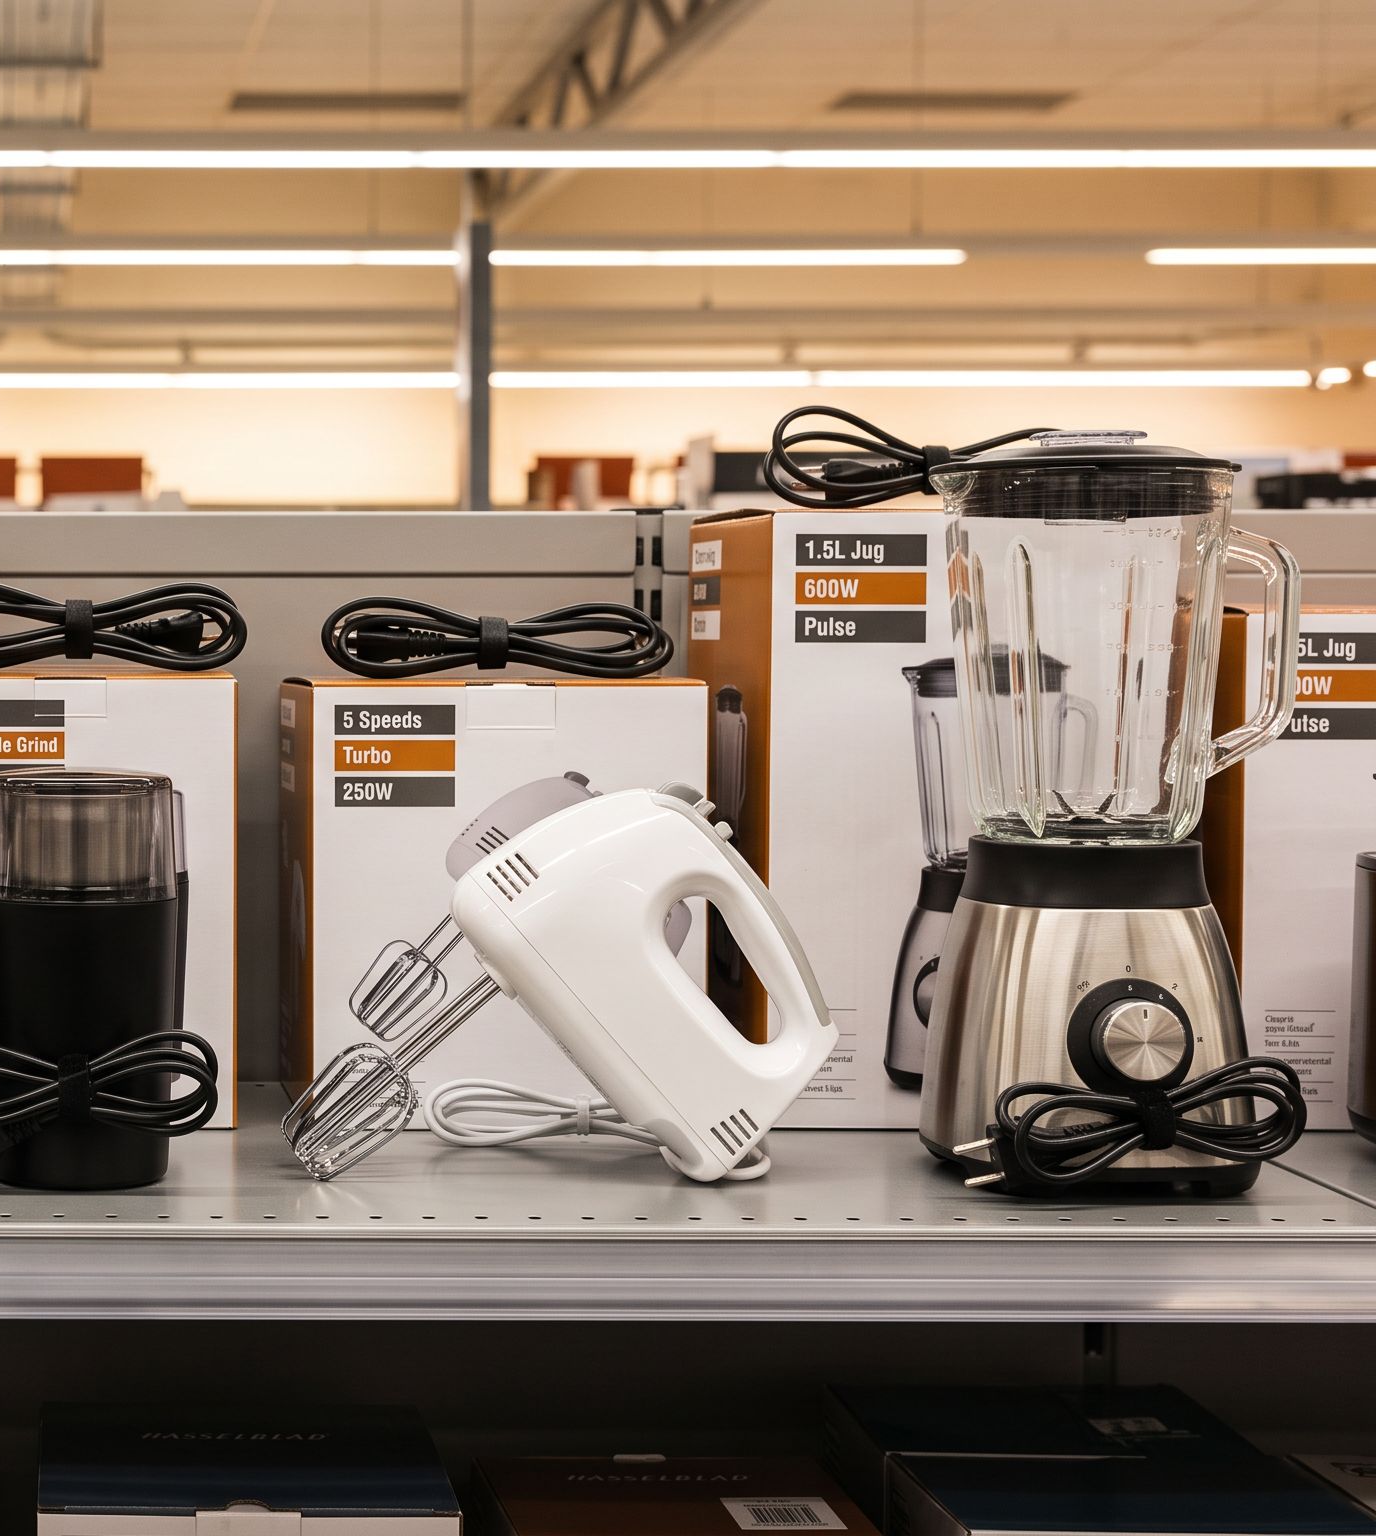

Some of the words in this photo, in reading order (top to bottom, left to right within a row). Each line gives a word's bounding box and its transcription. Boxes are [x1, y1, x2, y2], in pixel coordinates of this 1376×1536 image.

[805, 540, 846, 560] 1.5L
[850, 540, 884, 564] Jug
[804, 578, 859, 598] 600W
[804, 616, 856, 637] Pulse
[1298, 638, 1319, 657] 5L
[1322, 638, 1356, 662] Jug
[1296, 675, 1333, 696] 00W
[343, 711, 354, 729] 5
[359, 711, 422, 733] Speeds
[16, 736, 58, 753] Grind
[343, 746, 392, 764] Turbo
[343, 782, 393, 801] 250W
